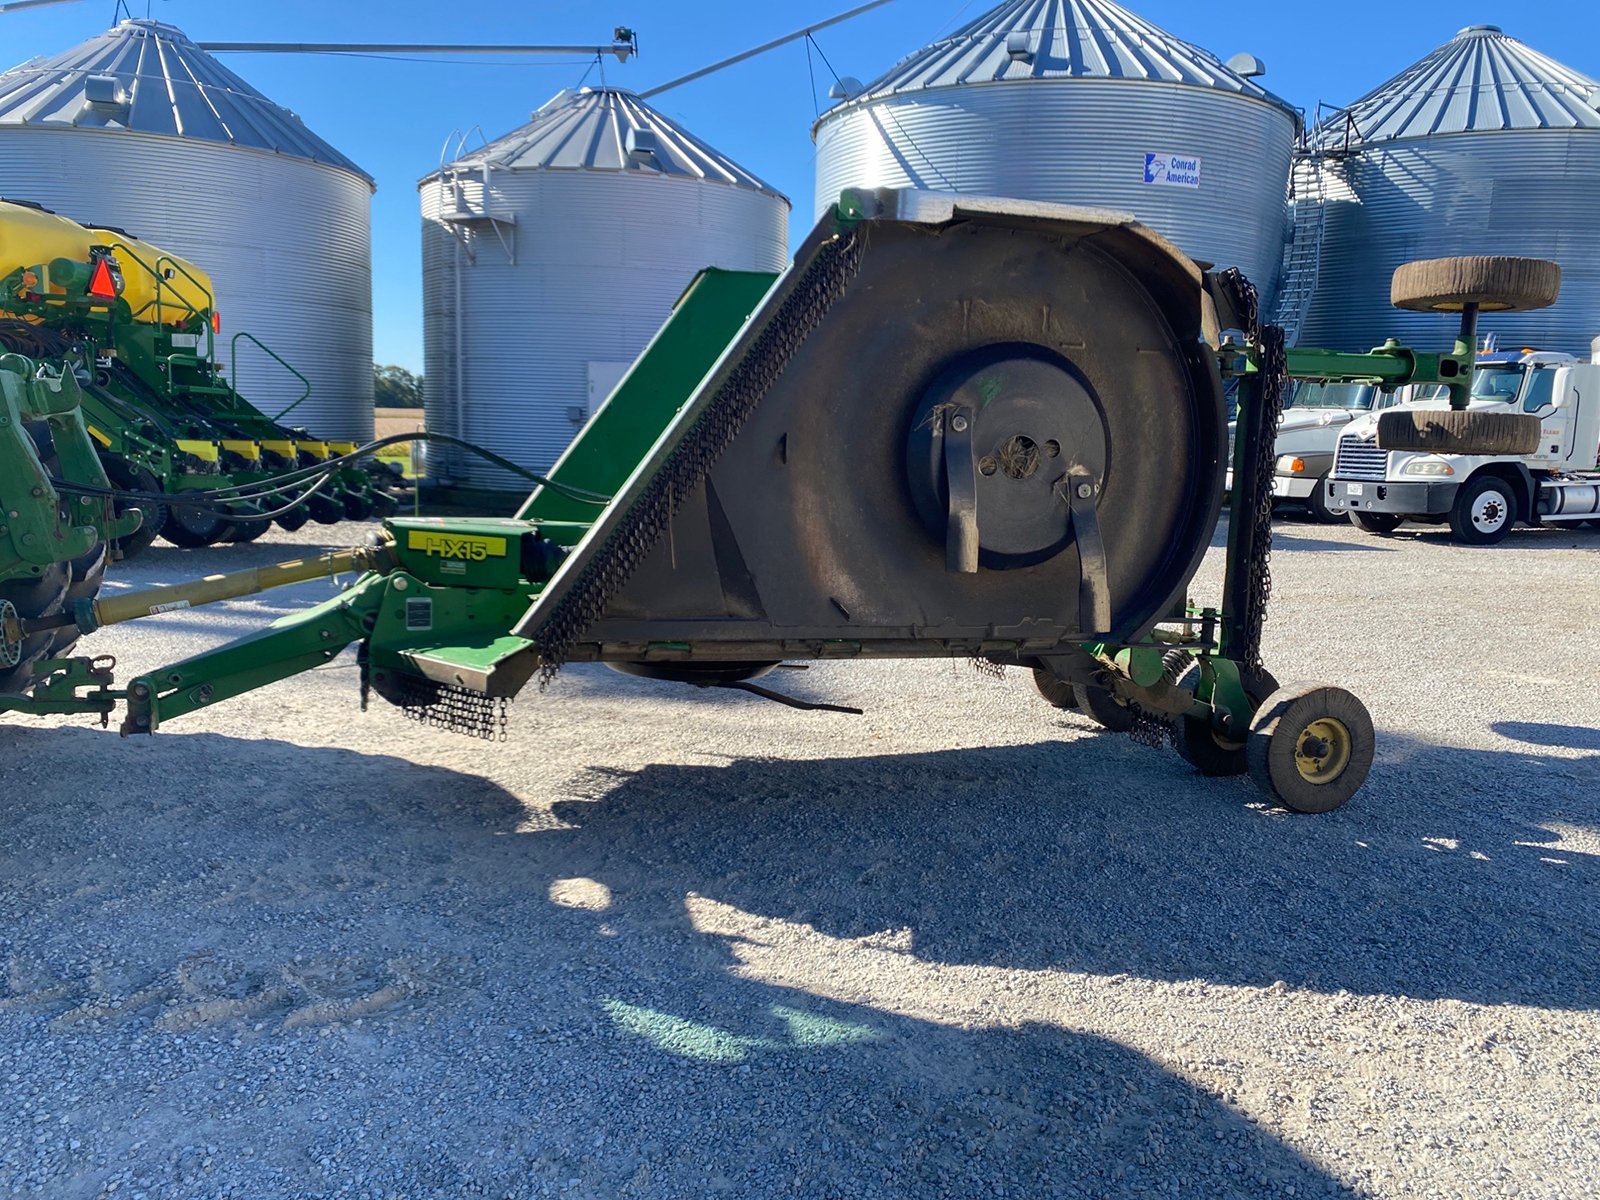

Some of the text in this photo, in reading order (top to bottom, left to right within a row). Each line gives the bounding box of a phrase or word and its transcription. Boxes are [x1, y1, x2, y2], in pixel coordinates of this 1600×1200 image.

[1171, 157, 1196, 171] Conrad
[1166, 170, 1199, 184] American
[426, 538, 487, 560] HX15
